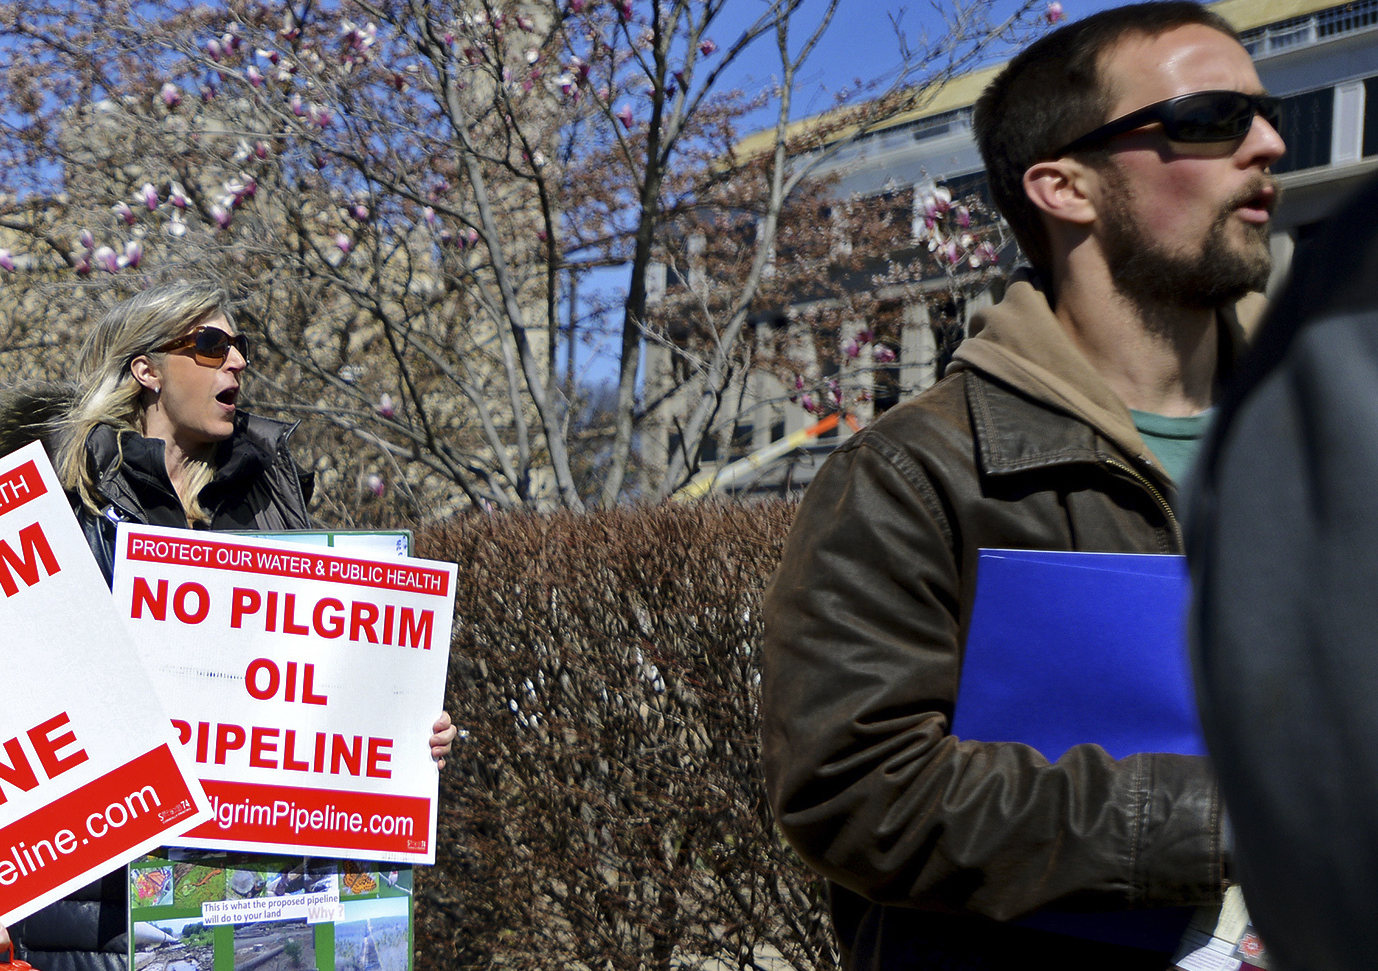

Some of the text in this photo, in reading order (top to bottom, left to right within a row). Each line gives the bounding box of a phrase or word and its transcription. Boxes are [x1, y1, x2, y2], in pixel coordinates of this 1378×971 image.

[132, 538, 441, 591] PROTECT OUR WATER & PUBLIC HEALTH
[130, 576, 435, 650] NO PILGRIM
[245, 657, 328, 706] OIL
[204, 894, 338, 912] This is what the proposed pipeline
[204, 909, 282, 924] will do to your land
[308, 906, 335, 921] Why
